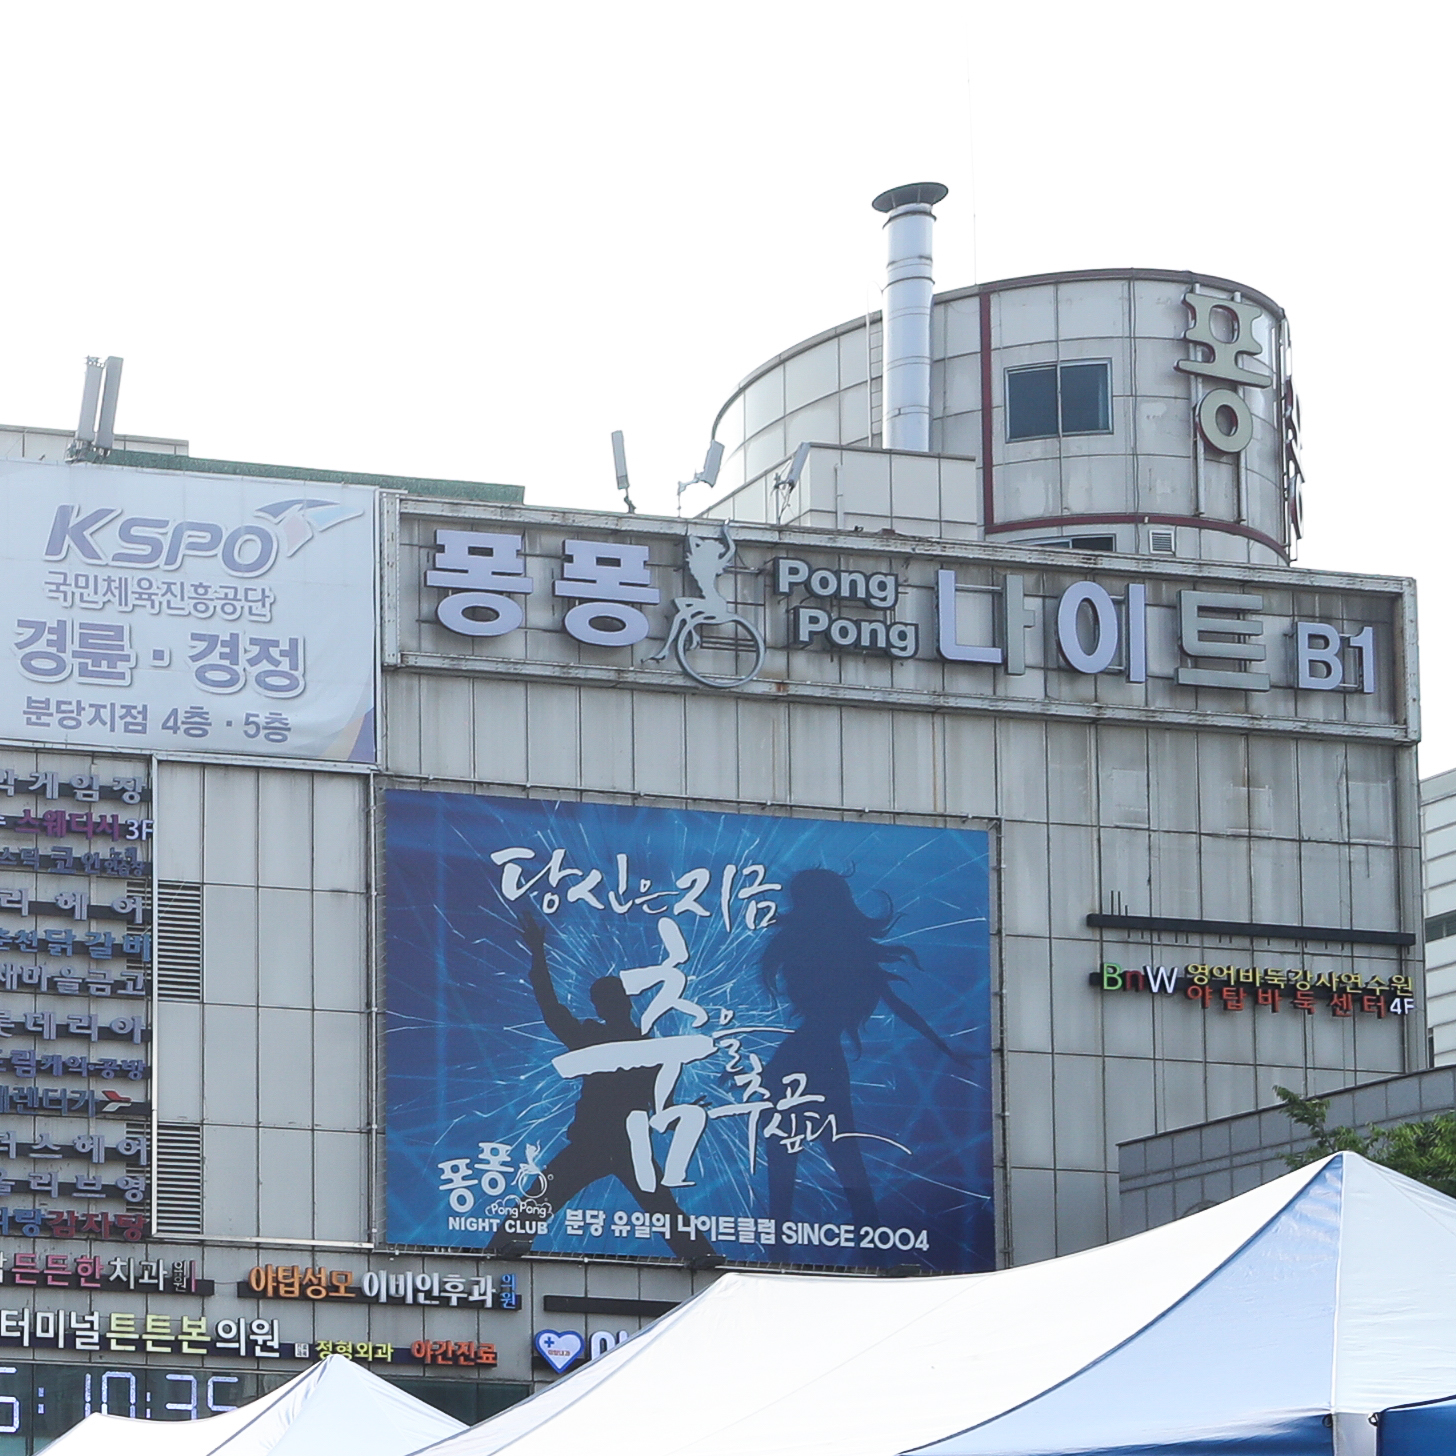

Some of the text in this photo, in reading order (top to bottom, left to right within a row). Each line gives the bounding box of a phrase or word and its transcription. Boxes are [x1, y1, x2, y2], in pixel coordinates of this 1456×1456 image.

[1174, 293, 1272, 452] 퐁
[44, 503, 281, 579] KSPO
[44, 570, 276, 623] 국민체육진흥공단
[425, 528, 1377, 694] 퐁퐁 Pong 나이트 B1
[794, 605, 922, 660] Pong
[14, 617, 307, 699] 경륜 경정
[23, 696, 292, 744] 분당지점 4층 5층
[14, 808, 120, 841] 스웨디시
[125, 818, 155, 842] 3F
[1102, 962, 1414, 996] BnW 영어바둑강사연수원
[1389, 997, 1415, 1016] 4F
[436, 1140, 515, 1214] 퐁퐁
[46, 1209, 148, 1241] 감자탕
[448, 1216, 549, 1236] NIGHT CLUB
[564, 1208, 930, 1252] 분당 유일의 나이트클럽 SINCE 2004
[11, 1252, 105, 1288] 든든한
[109, 1256, 168, 1292] 치과
[248, 1264, 517, 1309] 야탑성모 이비인후과 의원
[0, 1308, 498, 1367] 터미널 튼튼본 의원 정형외과 야간진료
